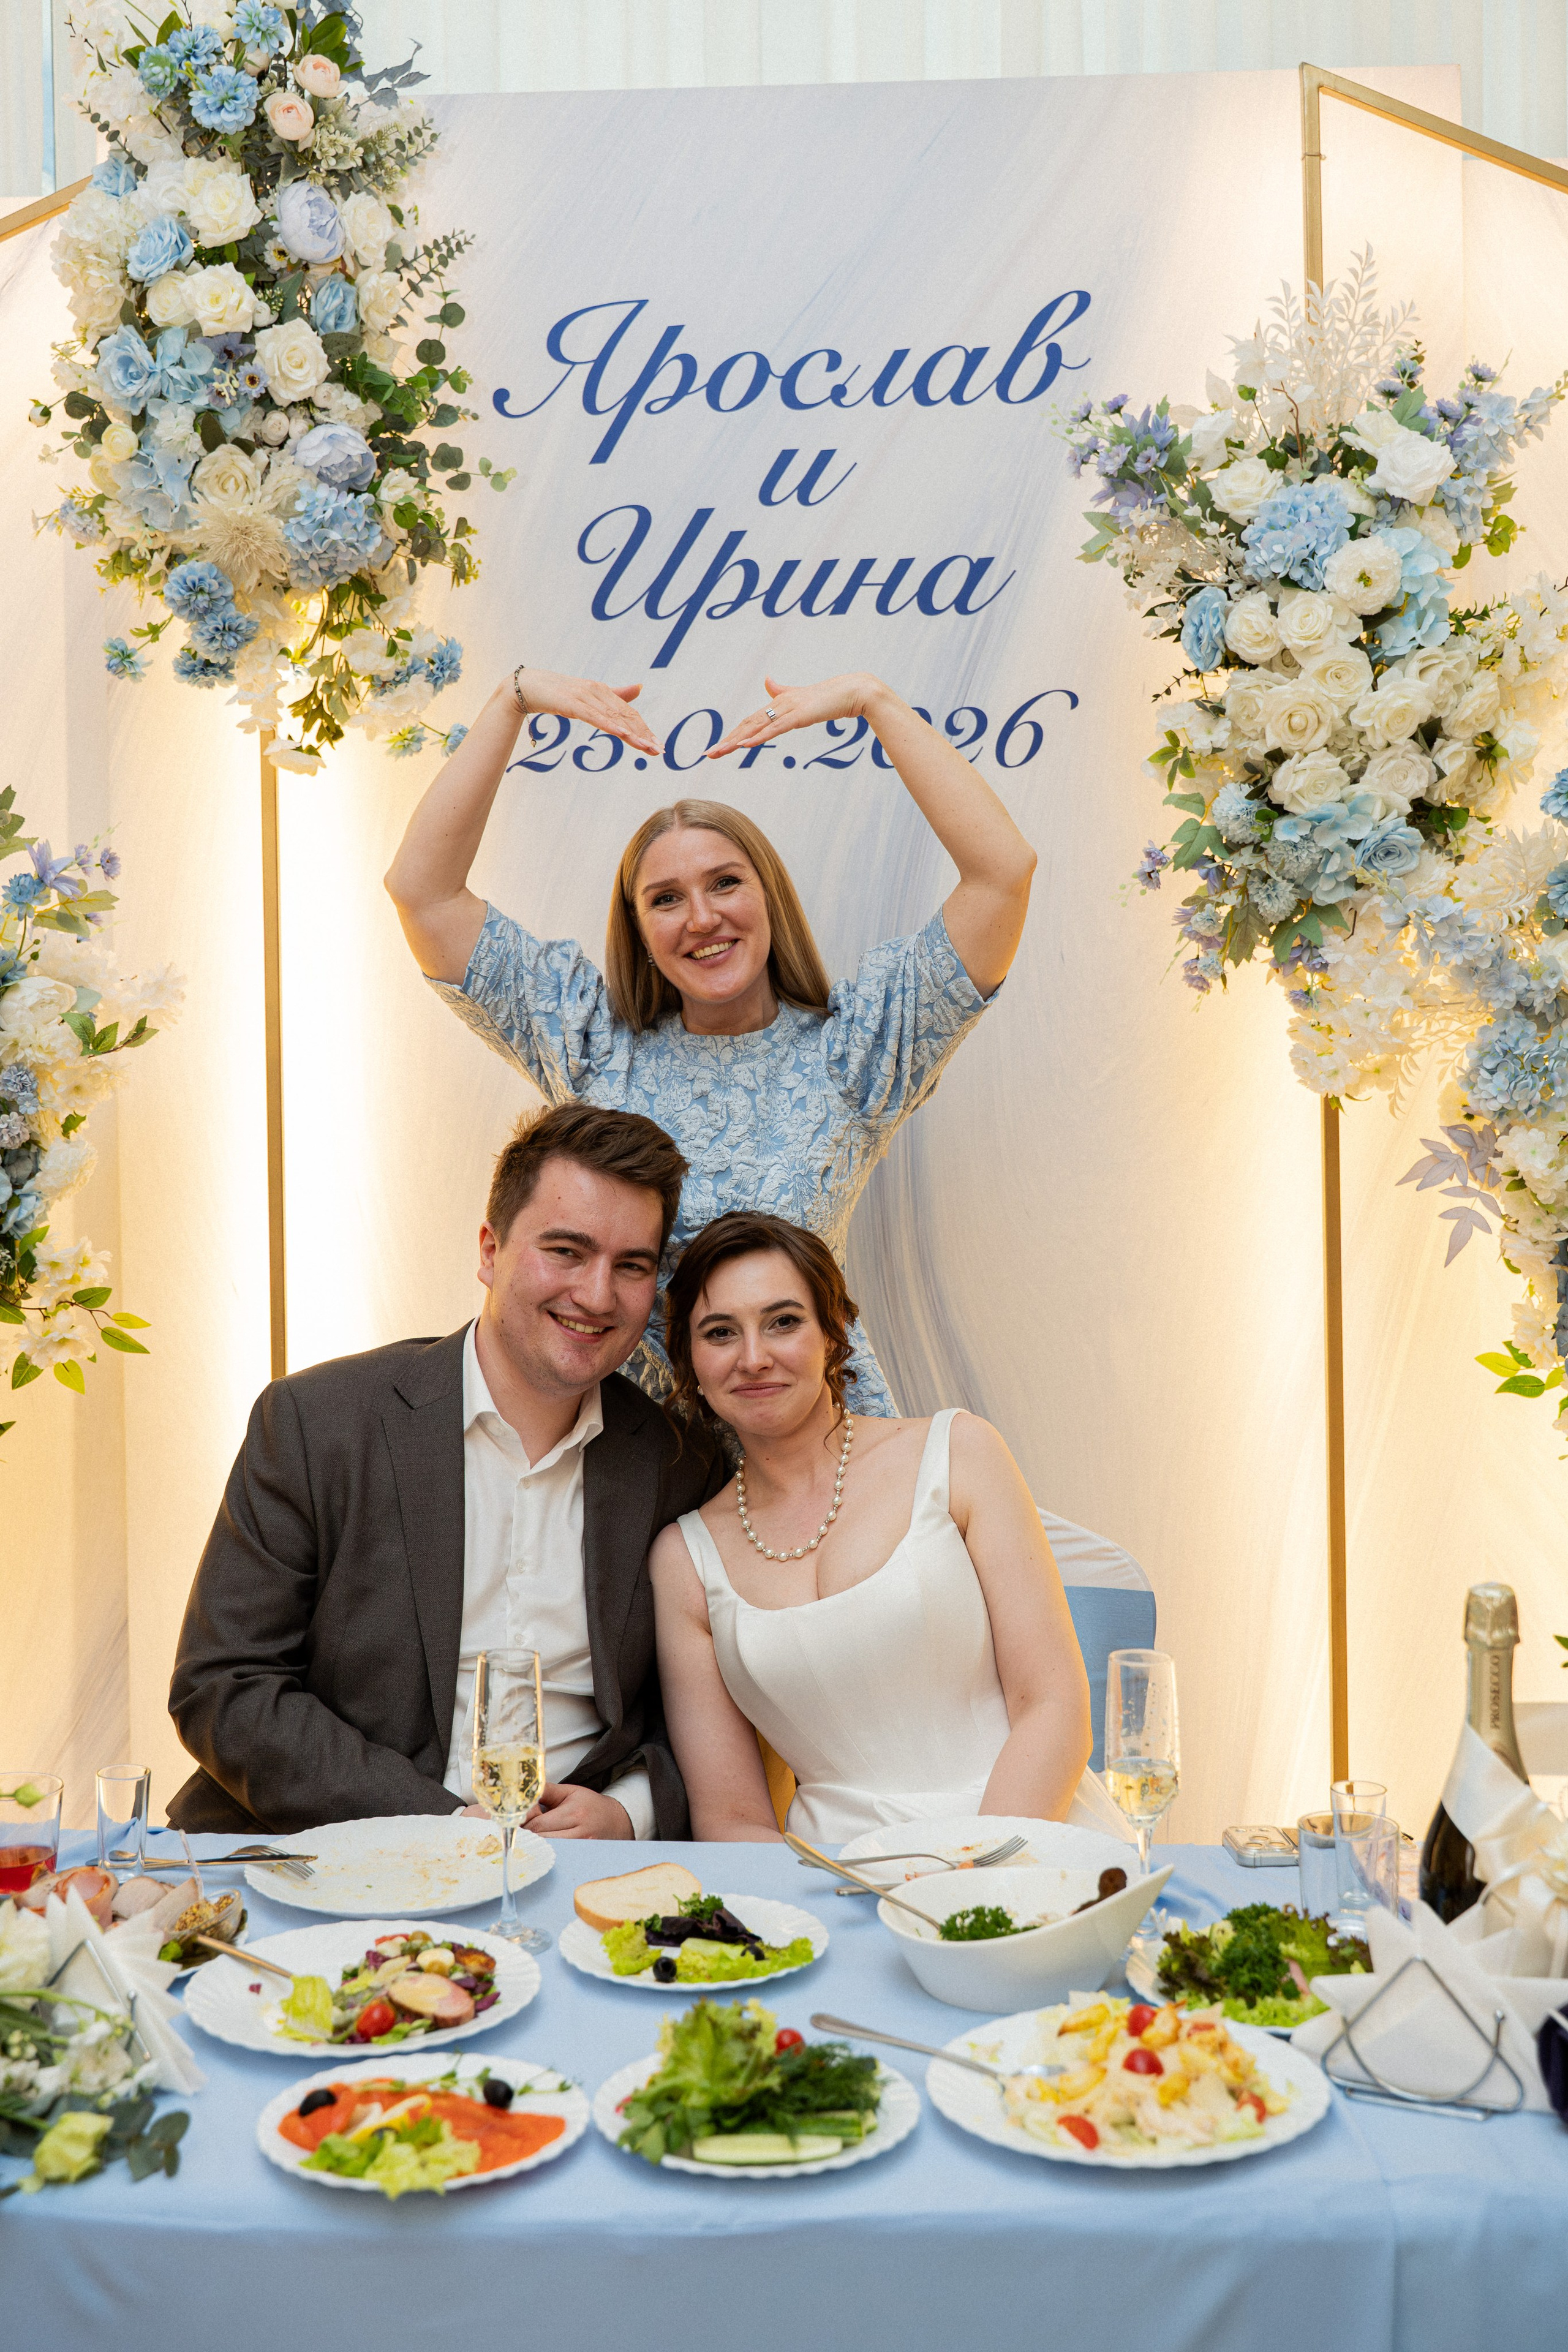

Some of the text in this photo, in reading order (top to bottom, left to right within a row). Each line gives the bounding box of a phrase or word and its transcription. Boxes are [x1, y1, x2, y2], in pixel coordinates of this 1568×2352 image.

[492, 290, 1092, 466] Ярослав
[758, 448, 858, 507] и
[576, 503, 1016, 669] Ирина
[1489, 1654, 1501, 1730] PROSECCO
